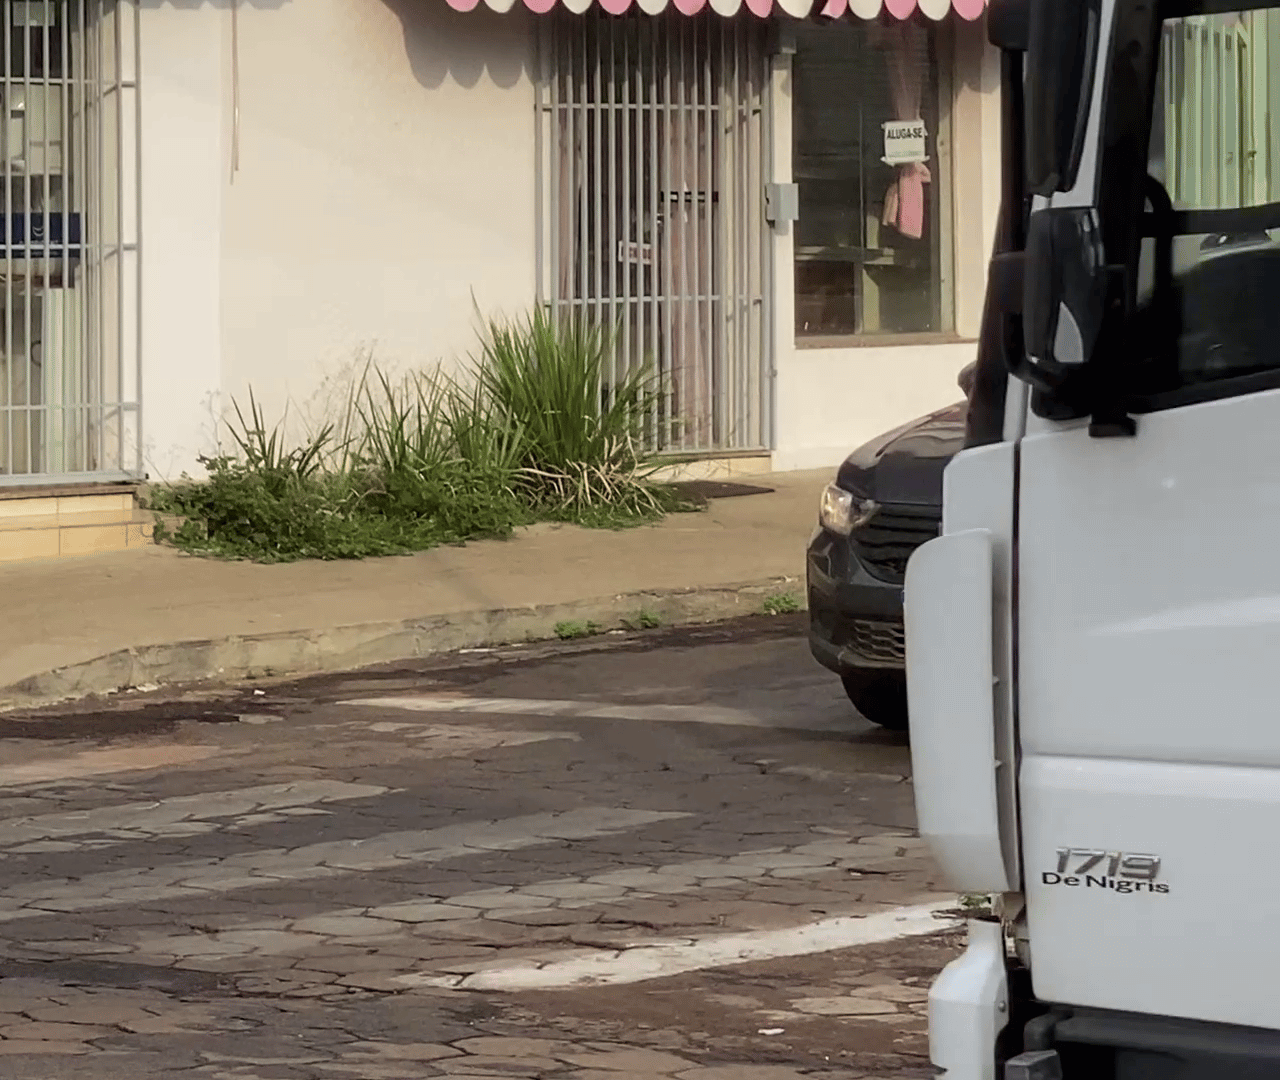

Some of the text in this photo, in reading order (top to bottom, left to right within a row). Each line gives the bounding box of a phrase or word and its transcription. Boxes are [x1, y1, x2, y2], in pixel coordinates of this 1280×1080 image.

[887, 127, 922, 139] ALUGA-SE
[1055, 846, 1161, 880] 1719
[1042, 872, 1170, 894] De Nigris
